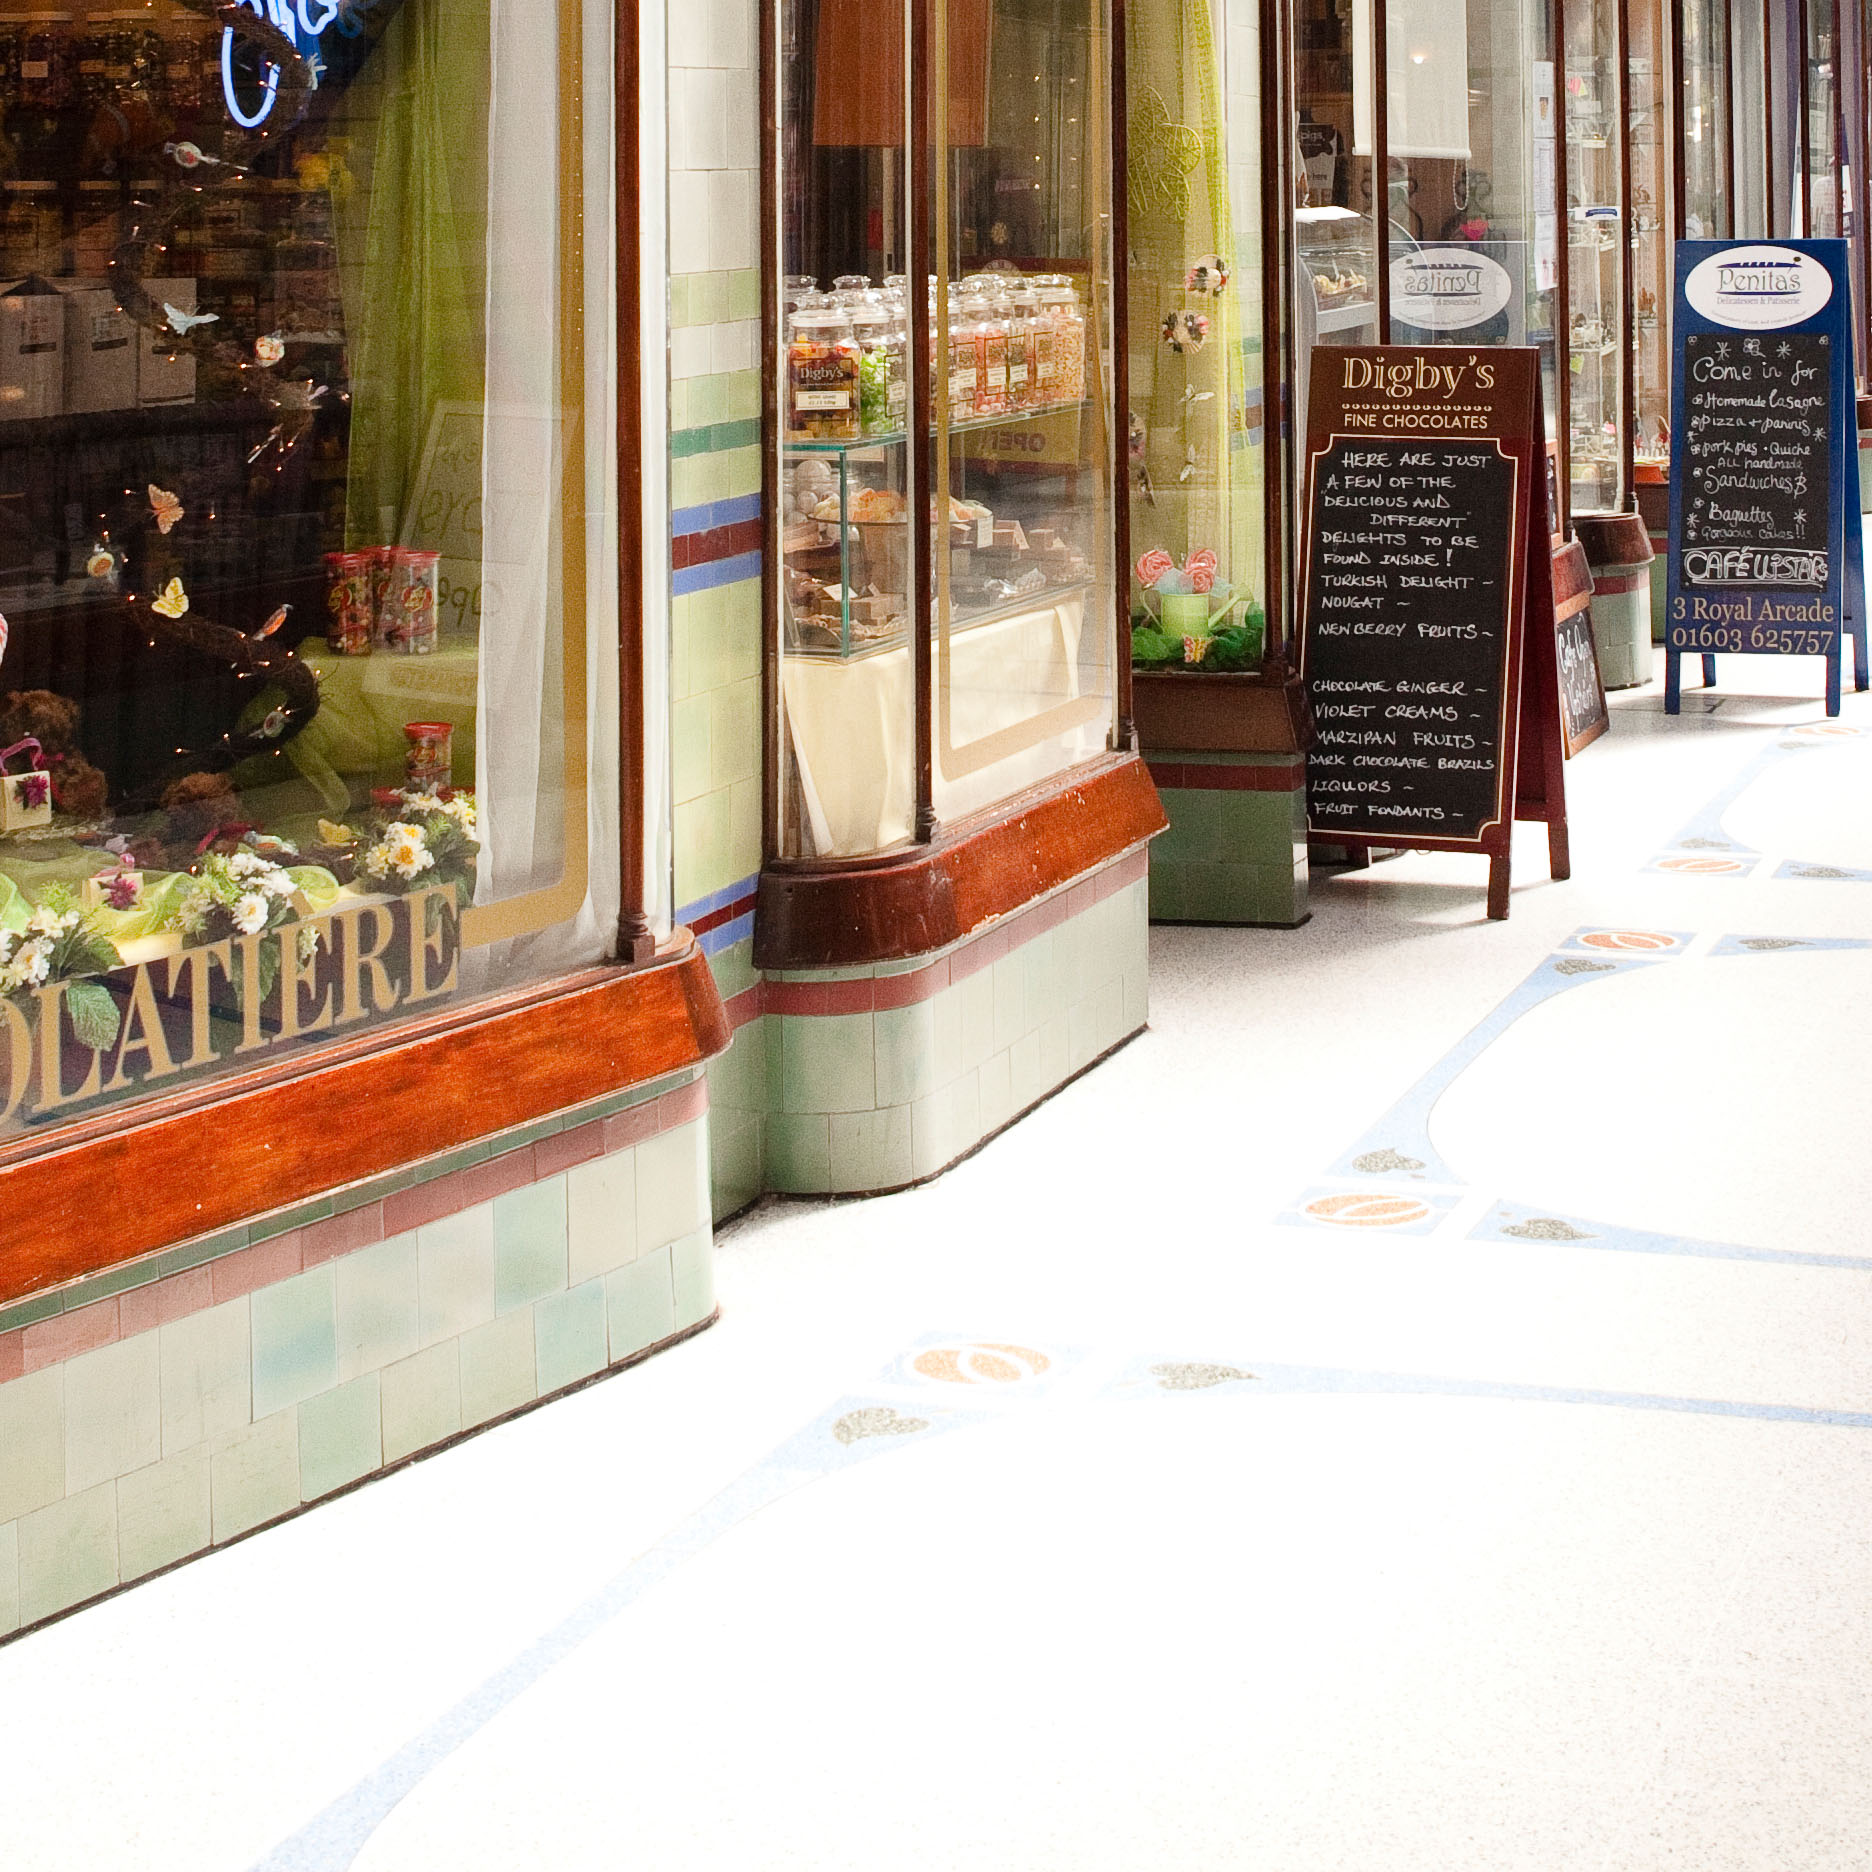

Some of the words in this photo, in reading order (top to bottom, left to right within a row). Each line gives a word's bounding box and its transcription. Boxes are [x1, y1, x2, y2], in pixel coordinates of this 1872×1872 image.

[801, 367, 843, 380] Digby's
[1342, 355, 1495, 398] Digby's
[1693, 357, 1752, 382] Come
[1762, 362, 1782, 378] in
[1791, 360, 1818, 385] for
[1704, 392, 1766, 409] Homemade
[1344, 414, 1376, 427] FINE
[1383, 414, 1488, 429] CHOCOLATES
[1699, 412, 1747, 431] pizza
[1761, 417, 1810, 436] paninis
[1703, 440, 1733, 457] pork
[1735, 440, 1757, 456] pies
[1769, 442, 1811, 455] Quiche
[1342, 453, 1393, 467] HERE
[1399, 453, 1435, 465] ARE
[1442, 455, 1492, 467] JUST
[1744, 457, 1803, 469] handmade
[1327, 474, 1339, 490] A
[1345, 474, 1382, 488] FEW
[1389, 477, 1414, 488] OF
[1420, 476, 1456, 488] THE
[1704, 466, 1793, 494] Sandwiches
[1412, 497, 1450, 508] AND
[1709, 502, 1774, 529] Baguettes
[1321, 531, 1407, 545] DELIGHTS
[1420, 536, 1442, 545] TO
[1451, 536, 1480, 548] BE
[1323, 553, 1371, 564] FOUND
[1321, 575, 1388, 588] TURKISH
[1399, 575, 1474, 589] DELIGHT
[1322, 596, 1385, 609] NOUGAT
[1673, 597, 1686, 619] 3
[1693, 597, 1752, 625] Royal
[1760, 598, 1834, 622] Arcade
[1417, 624, 1478, 639] FRUITS
[1673, 627, 1742, 652] 01603
[1751, 624, 1833, 653] 625757
[1312, 680, 1389, 692] CHOCOLATE
[1396, 681, 1468, 696] GINGER
[1315, 704, 1376, 718] VIOLET
[1385, 706, 1458, 720] CREAMS
[1412, 732, 1476, 749] FRUITS
[1308, 754, 1346, 765] DARK
[1353, 755, 1430, 769] CHOCOLATE
[1437, 758, 1495, 769] BRAZILS
[1312, 780, 1391, 793] LIQUORS
[1314, 802, 1358, 815] FRUIT
[1368, 805, 1445, 819] FONDANTS
